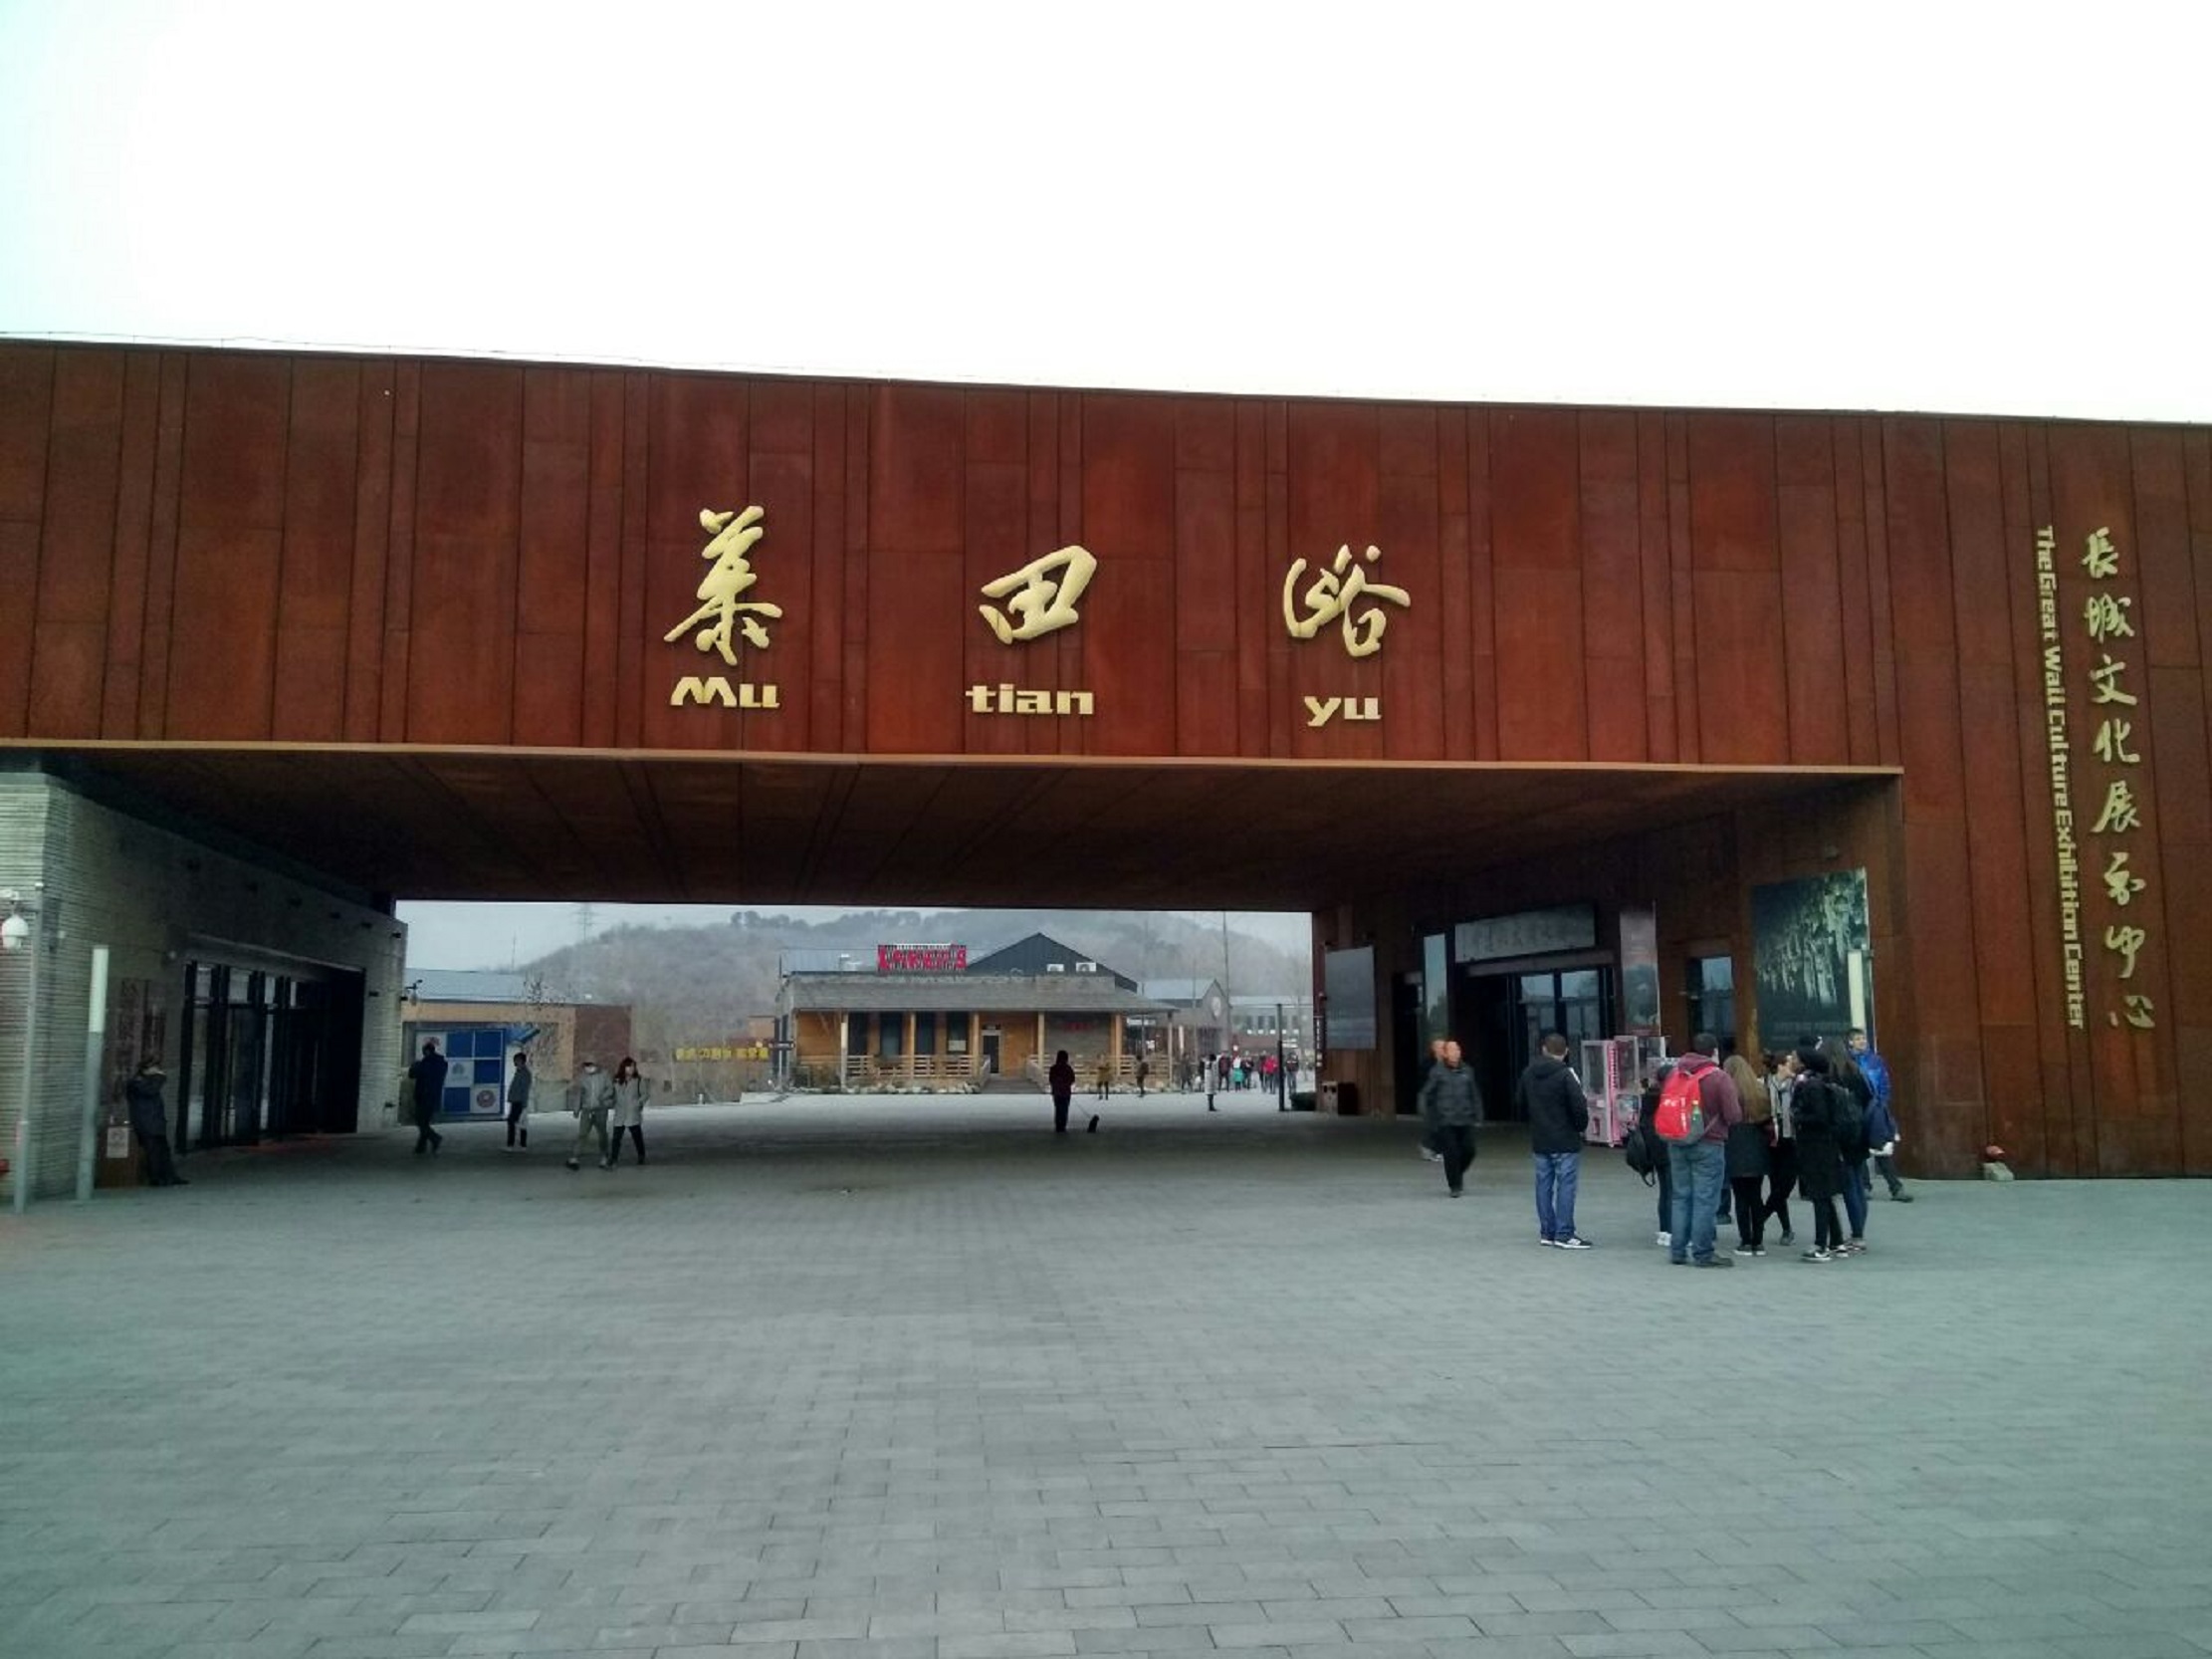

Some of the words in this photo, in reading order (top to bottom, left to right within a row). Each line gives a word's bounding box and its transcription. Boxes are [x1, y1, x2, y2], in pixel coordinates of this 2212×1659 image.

[2037, 526, 2056, 571] The
[2039, 573, 2059, 642] Great
[671, 677, 779, 708] Mu
[966, 684, 1093, 715] tian
[1304, 696, 1381, 727] yu
[2044, 646, 2066, 706] Wall
[2048, 710, 2070, 807] Culture
[2056, 811, 2080, 941] Exhibition
[2064, 944, 2084, 1029] Center
